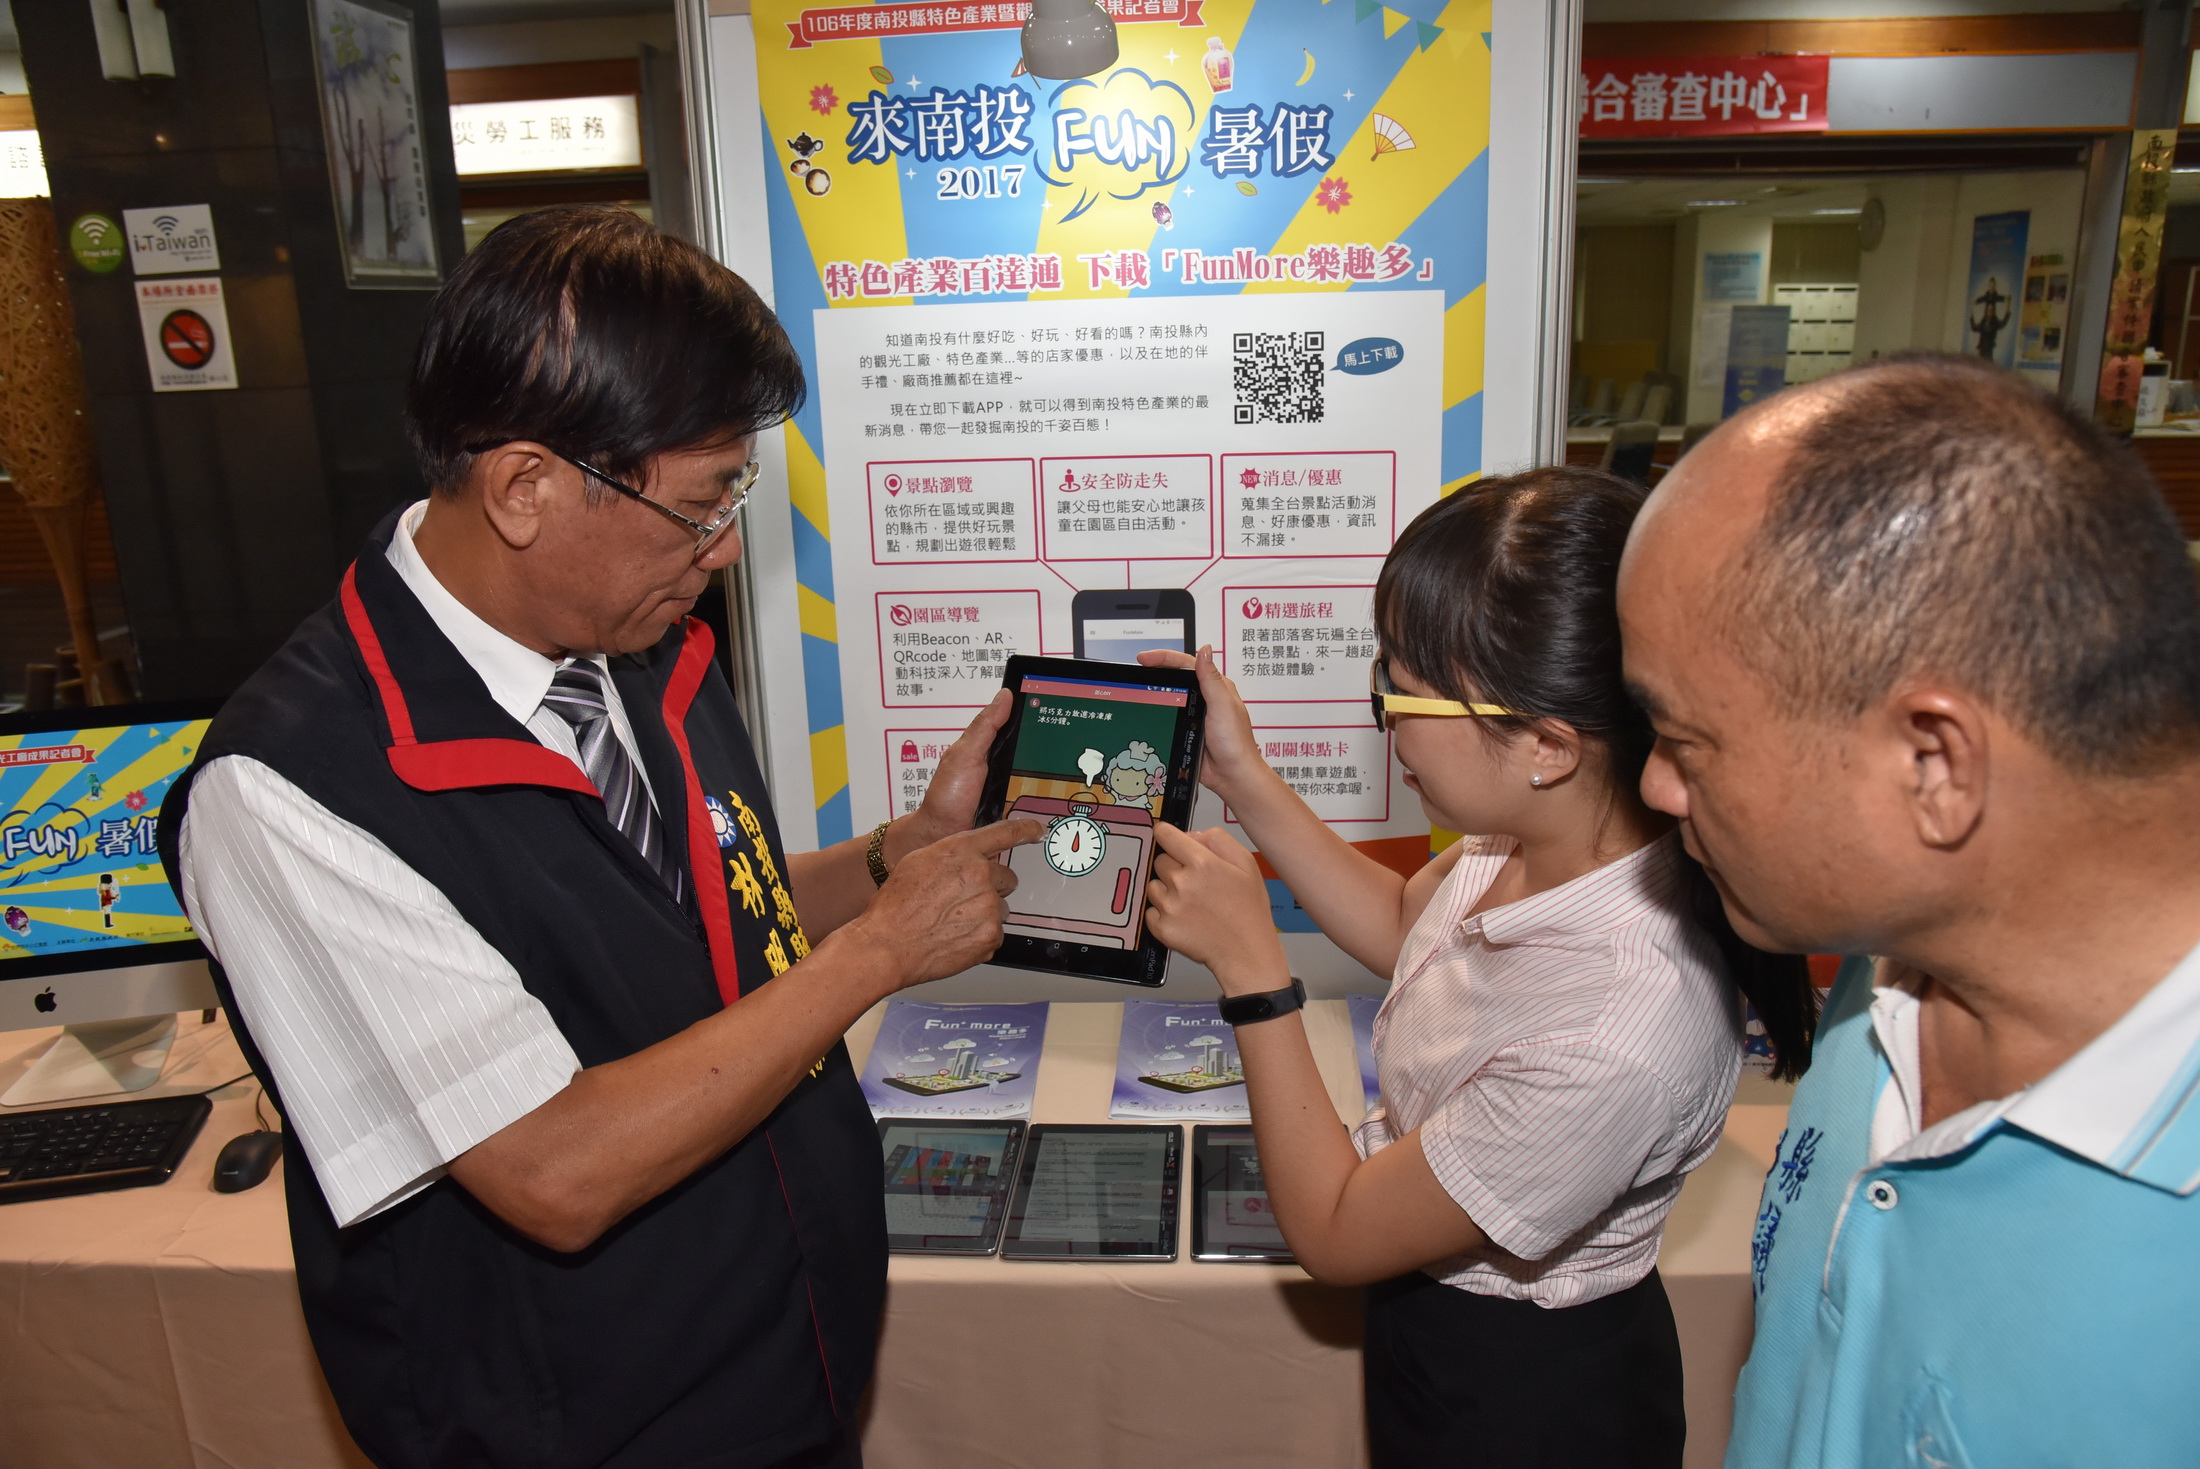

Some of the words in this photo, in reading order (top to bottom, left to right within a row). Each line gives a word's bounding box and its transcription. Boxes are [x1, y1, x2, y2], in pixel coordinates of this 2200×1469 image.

[1098, 0, 1179, 16] 果記者會
[852, 86, 1031, 161] 來南投
[1055, 111, 1177, 178] FUN
[1208, 107, 1331, 174] 暑假
[937, 166, 1023, 199] 2017
[825, 255, 1063, 297] 特色產業百達通
[1079, 252, 1149, 288] 下載
[1344, 345, 1398, 368] 馬上下載
[906, 476, 974, 494] 景點瀏覽
[1081, 471, 1169, 491] 安全防走失
[1262, 468, 1342, 487] 消息/優惠
[885, 502, 1015, 518] 依你所在區域或興趣
[1057, 498, 1205, 514] 讓父母也能安心地讓孩
[1241, 495, 1376, 512] 蒐集全台景點活動消
[1057, 515, 1186, 532] 童在園區自由活動。
[1241, 532, 1296, 547] 不漏接。
[913, 607, 980, 624] 園區導覽
[1264, 602, 1333, 619] 精選旅程
[893, 632, 1013, 646] 利用Beacon、AR、
[1242, 627, 1374, 642] 跟著部落客玩遍全台
[1242, 662, 1325, 677] 夯旅遊體驗。
[896, 683, 933, 697] 故事。
[902, 752, 918, 760] sale
[1265, 741, 1350, 758] 闖關集點卡
[904, 800, 922, 812] 報
[3, 826, 78, 860] FUN
